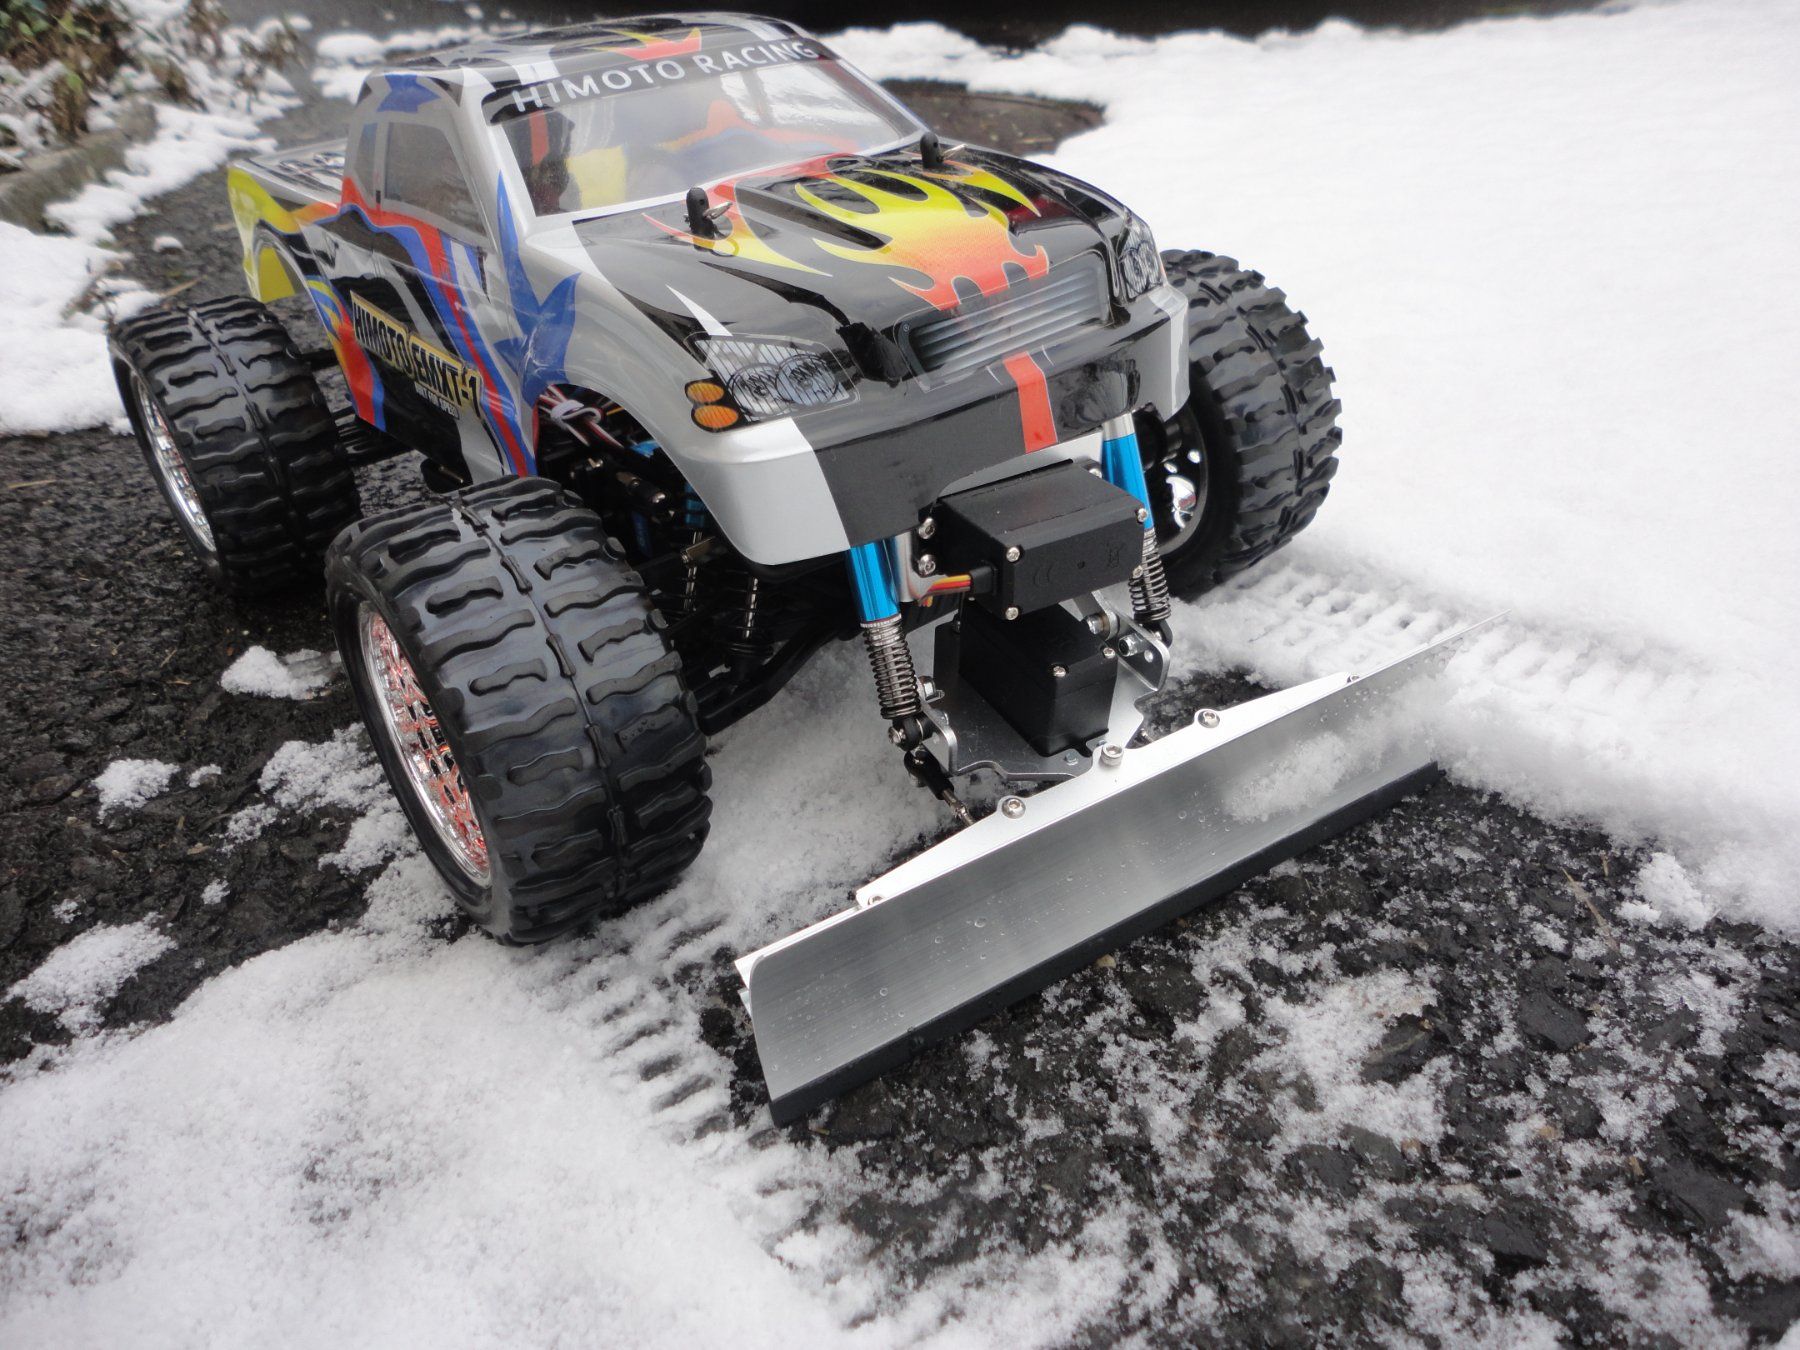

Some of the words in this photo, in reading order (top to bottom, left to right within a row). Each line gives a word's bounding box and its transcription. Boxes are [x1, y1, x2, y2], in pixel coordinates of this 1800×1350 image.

[511, 60, 686, 112] HIMOTO
[692, 38, 819, 75] RACING
[353, 302, 414, 375] HIMOTO
[411, 343, 481, 418] EMXT-1
